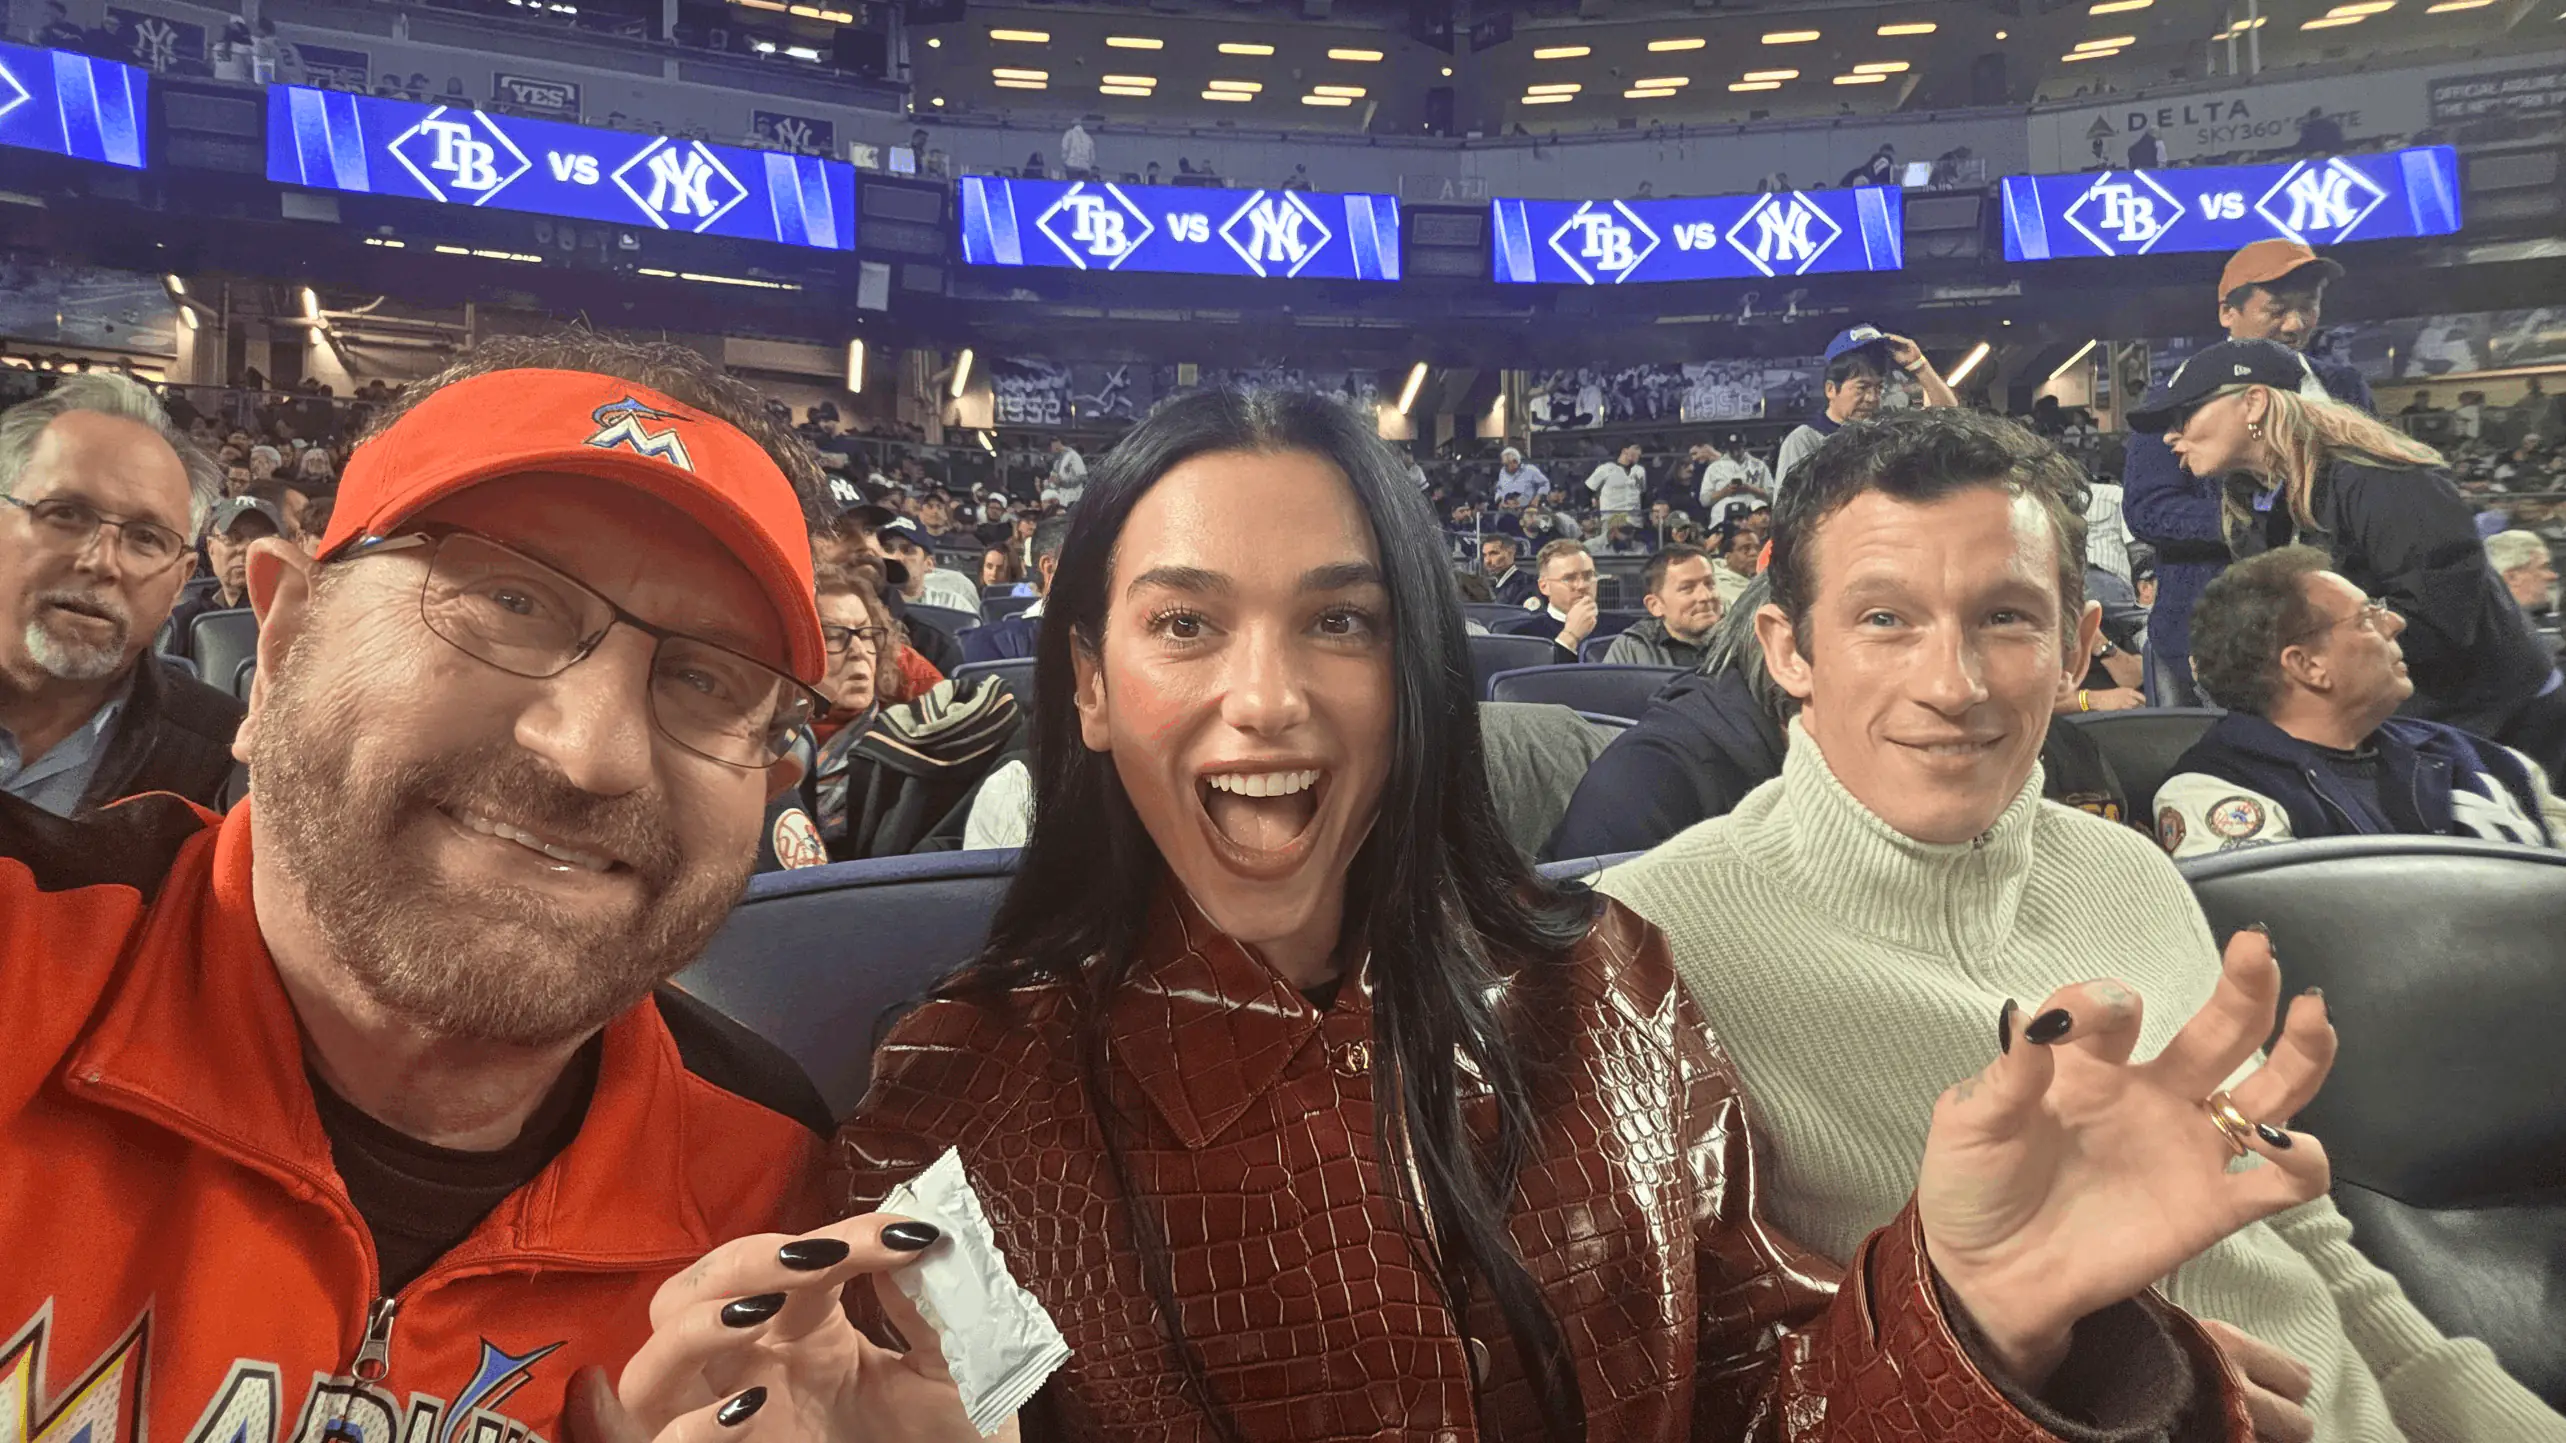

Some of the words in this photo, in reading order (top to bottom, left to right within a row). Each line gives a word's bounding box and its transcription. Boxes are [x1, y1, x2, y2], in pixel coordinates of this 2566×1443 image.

[511, 84, 566, 108] YES
[2127, 100, 2250, 132] DELTA
[420, 118, 499, 191] TB
[547, 151, 600, 185] VS
[647, 147, 719, 216] NY
[1062, 195, 1128, 256] TB
[1166, 213, 1210, 243] VS
[1248, 198, 1306, 262] NY
[1572, 212, 1636, 271] TB
[1673, 222, 1717, 251] VS
[1756, 200, 1816, 262] NY
[2090, 183, 2158, 242] TB
[2198, 191, 2246, 221] VS
[2286, 168, 2357, 230] NY
